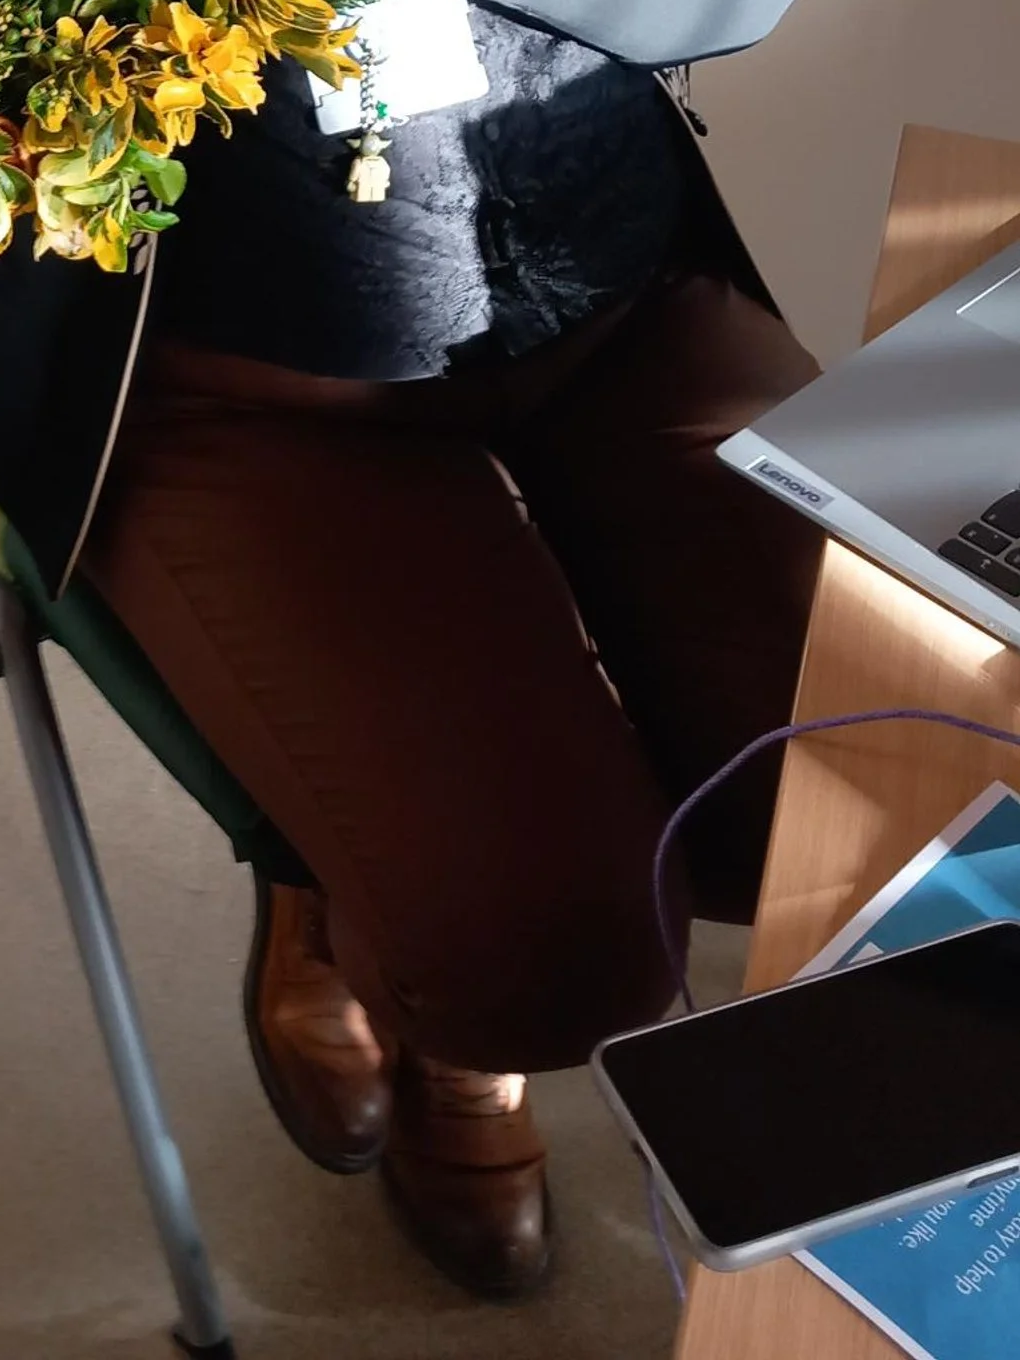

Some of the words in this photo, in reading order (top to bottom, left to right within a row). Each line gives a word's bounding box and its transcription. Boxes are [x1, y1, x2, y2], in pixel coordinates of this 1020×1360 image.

[758, 463, 821, 503] Lenovo
[968, 1177, 1020, 1228] nytime
[898, 1220, 938, 1249] like.
[983, 1244, 1007, 1264] to
[954, 1260, 996, 1295] help
